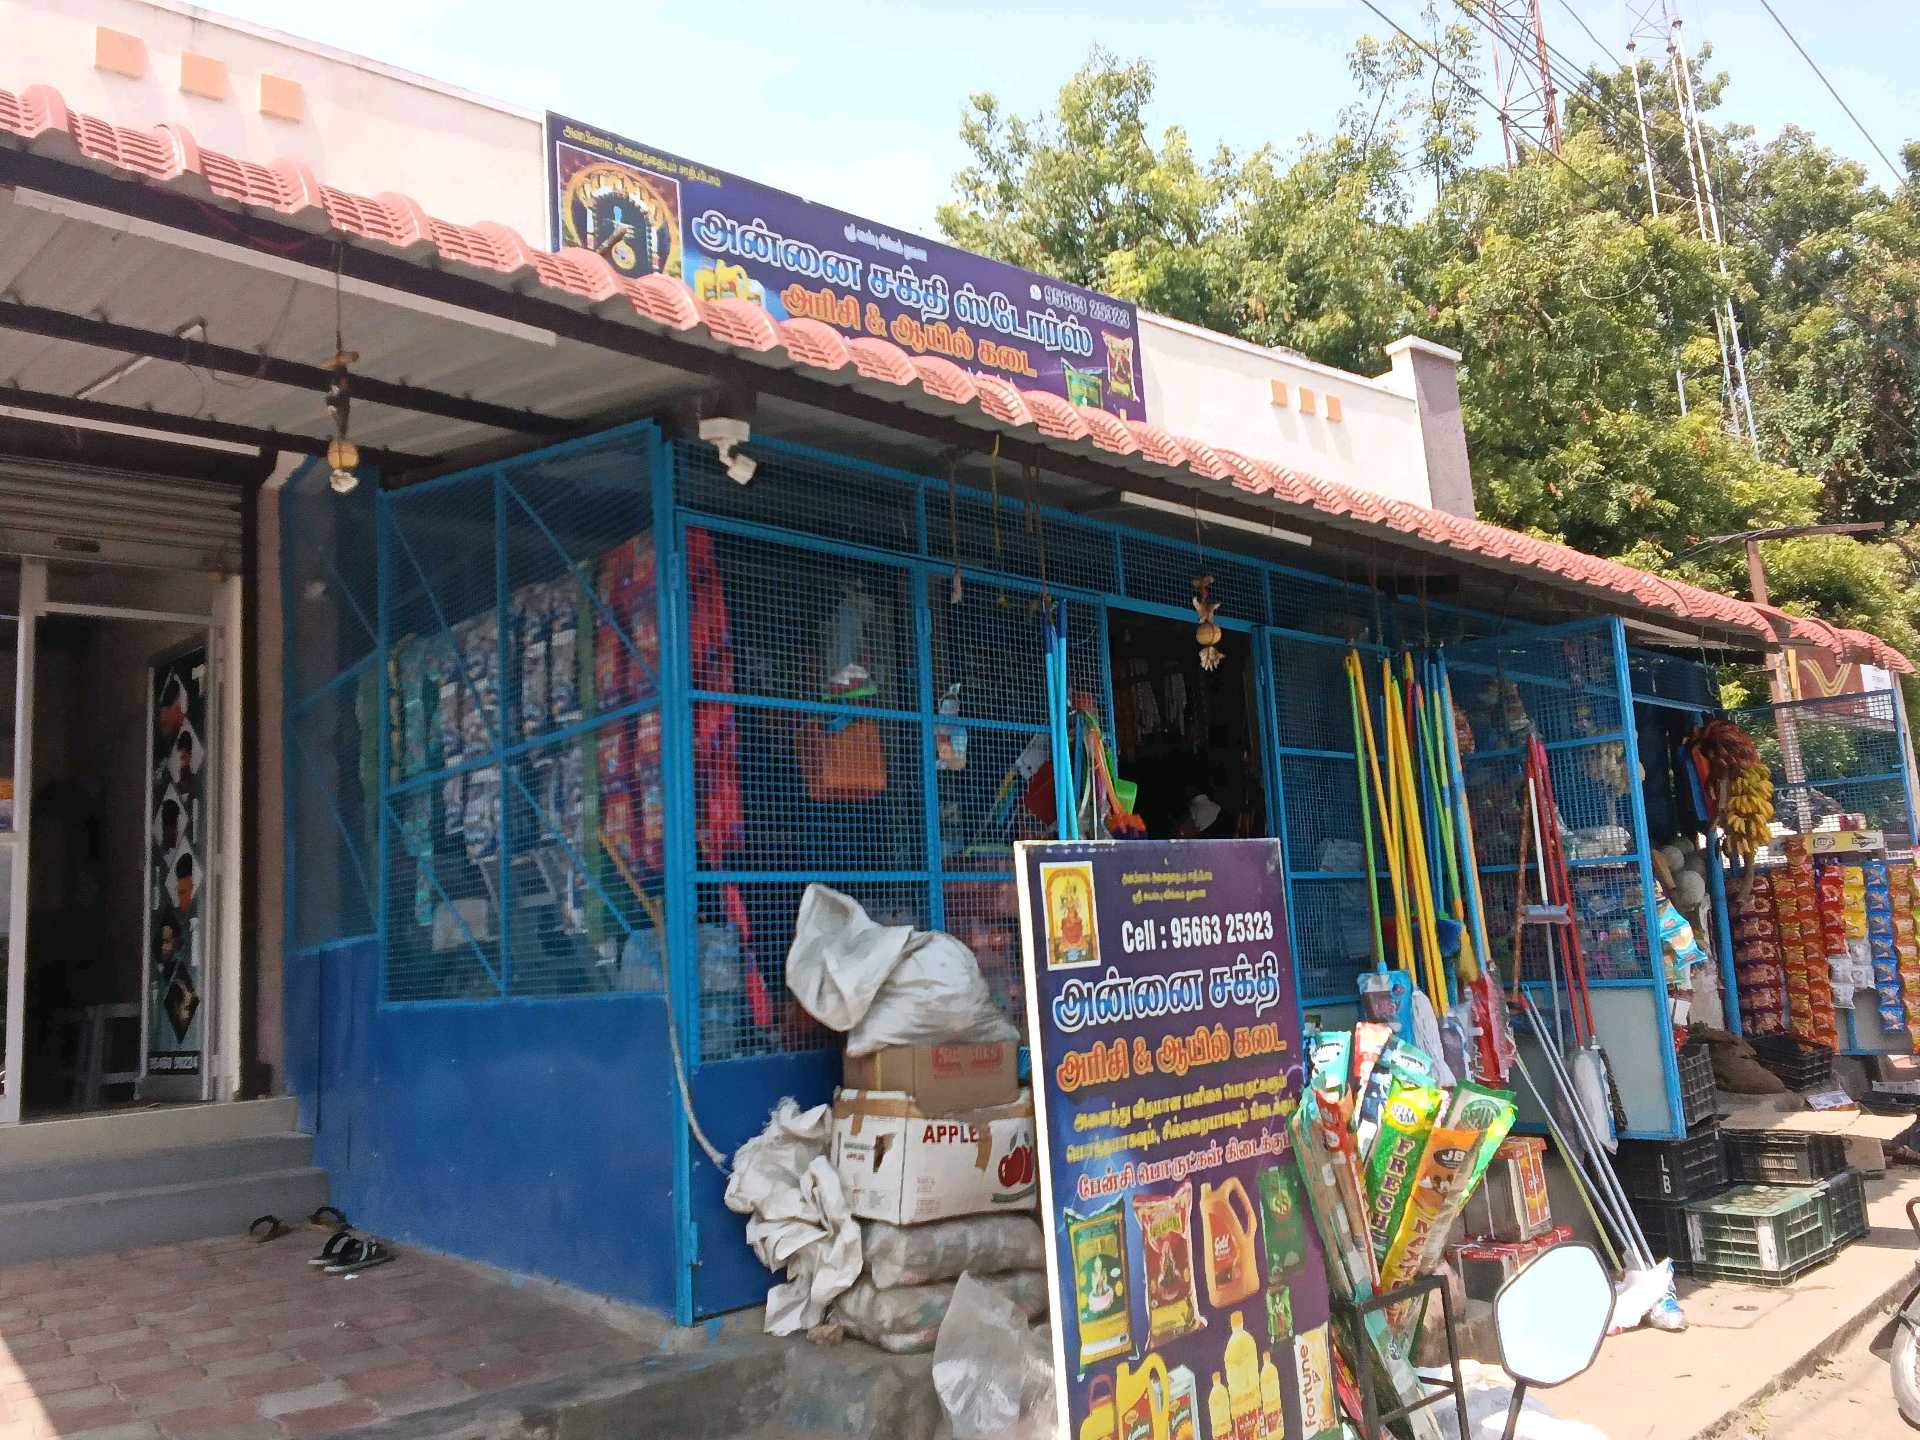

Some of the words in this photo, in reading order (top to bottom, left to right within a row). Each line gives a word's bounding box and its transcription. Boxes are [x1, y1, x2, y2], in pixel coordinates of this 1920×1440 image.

[692, 209, 862, 290] அன்னை
[867, 265, 949, 322] சக்தி
[954, 282, 1093, 357] ஸ்டோர்ஸ்
[780, 283, 861, 331] அரிசி
[865, 302, 888, 337] &
[891, 313, 974, 361] ஆயில்
[979, 338, 1038, 378] கடை
[1122, 920, 1156, 953] Cell
[1171, 915, 1222, 949] 95663
[1226, 910, 1274, 943] 25323
[1052, 966, 1203, 1033] அன்னை
[1209, 950, 1279, 1018] சக்தி
[1057, 1039, 1129, 1092] அரிசி
[1133, 1036, 1153, 1074] &
[1156, 1023, 1231, 1076] ஆயில்
[1233, 1022, 1287, 1059] கடை
[1074, 1101, 1131, 1132] அனைத்து
[1133, 1096, 1182, 1120] விதமான
[1078, 1162, 1134, 1201] பேன்சி
[1138, 1139, 1223, 1185] பொருட்கள்
[1300, 1344, 1316, 1428] fortune
